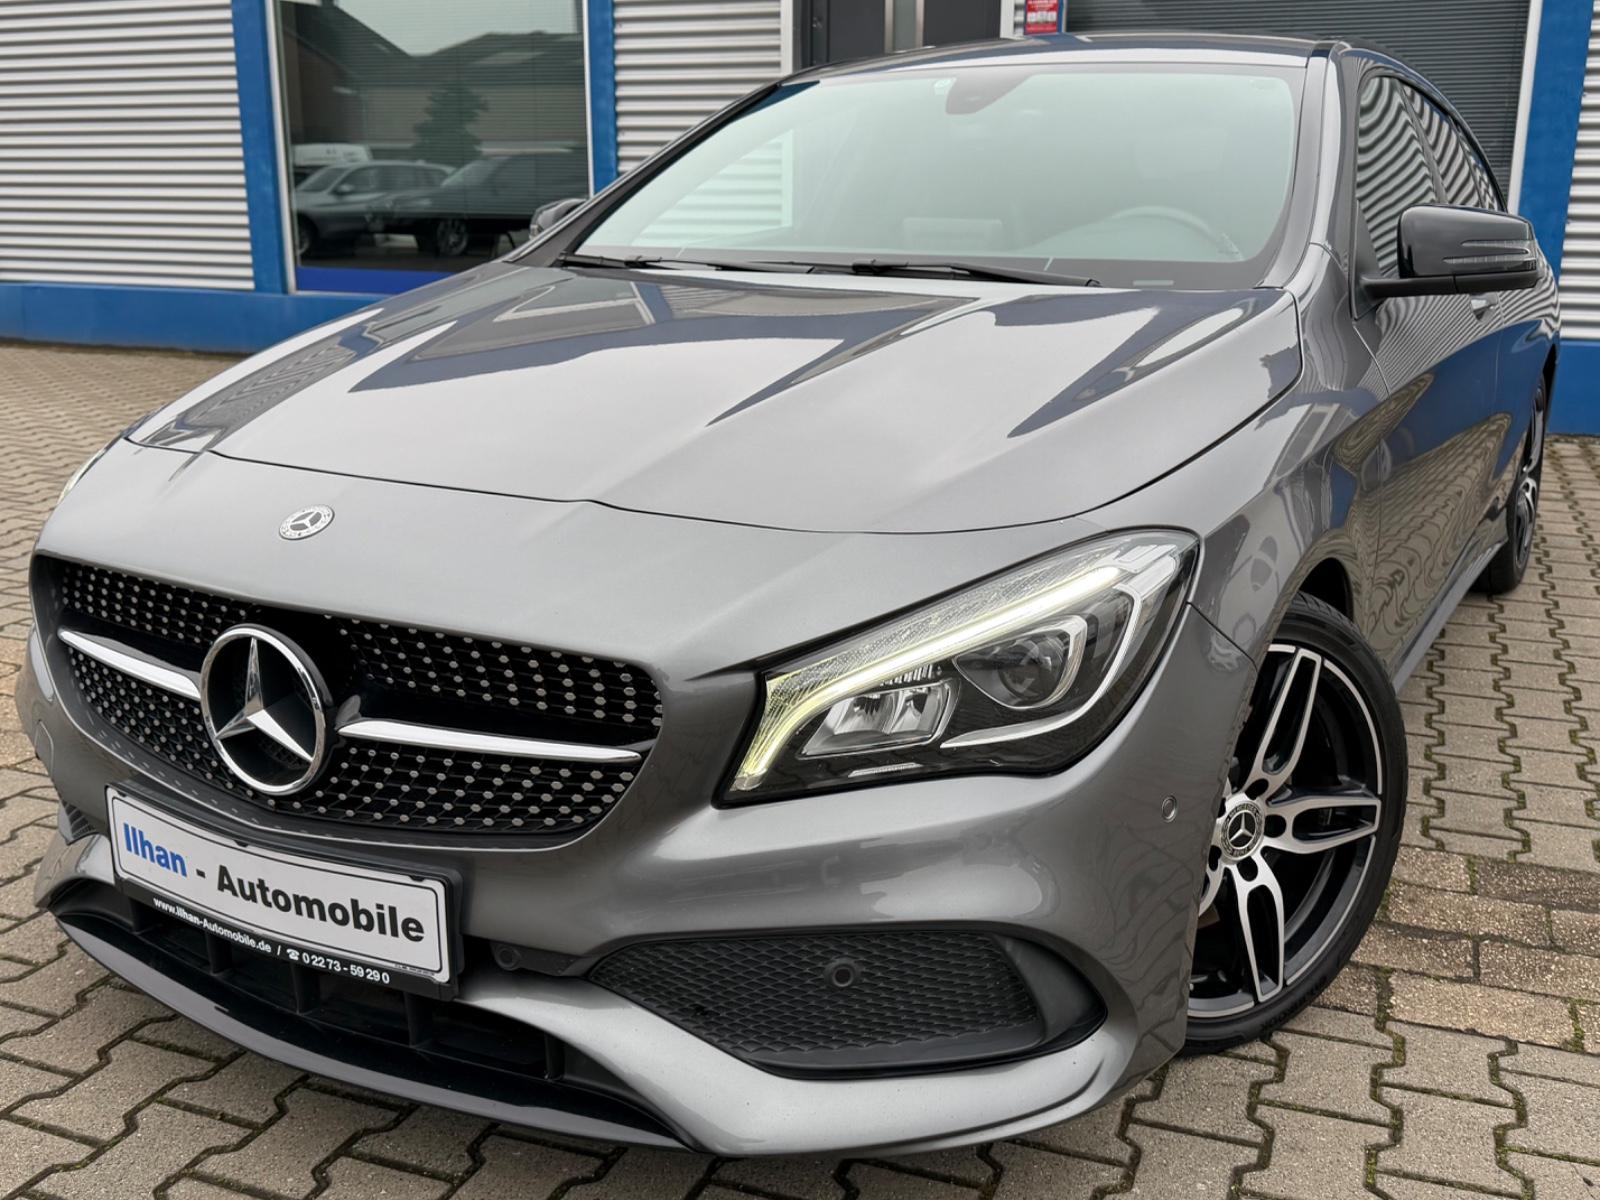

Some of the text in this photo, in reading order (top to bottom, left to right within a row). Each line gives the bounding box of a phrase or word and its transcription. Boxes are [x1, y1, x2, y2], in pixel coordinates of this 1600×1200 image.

[123, 823, 188, 877] Ilhan
[217, 864, 425, 943] Automobile
[153, 897, 272, 954] www.Ilhan-Automobile.de
